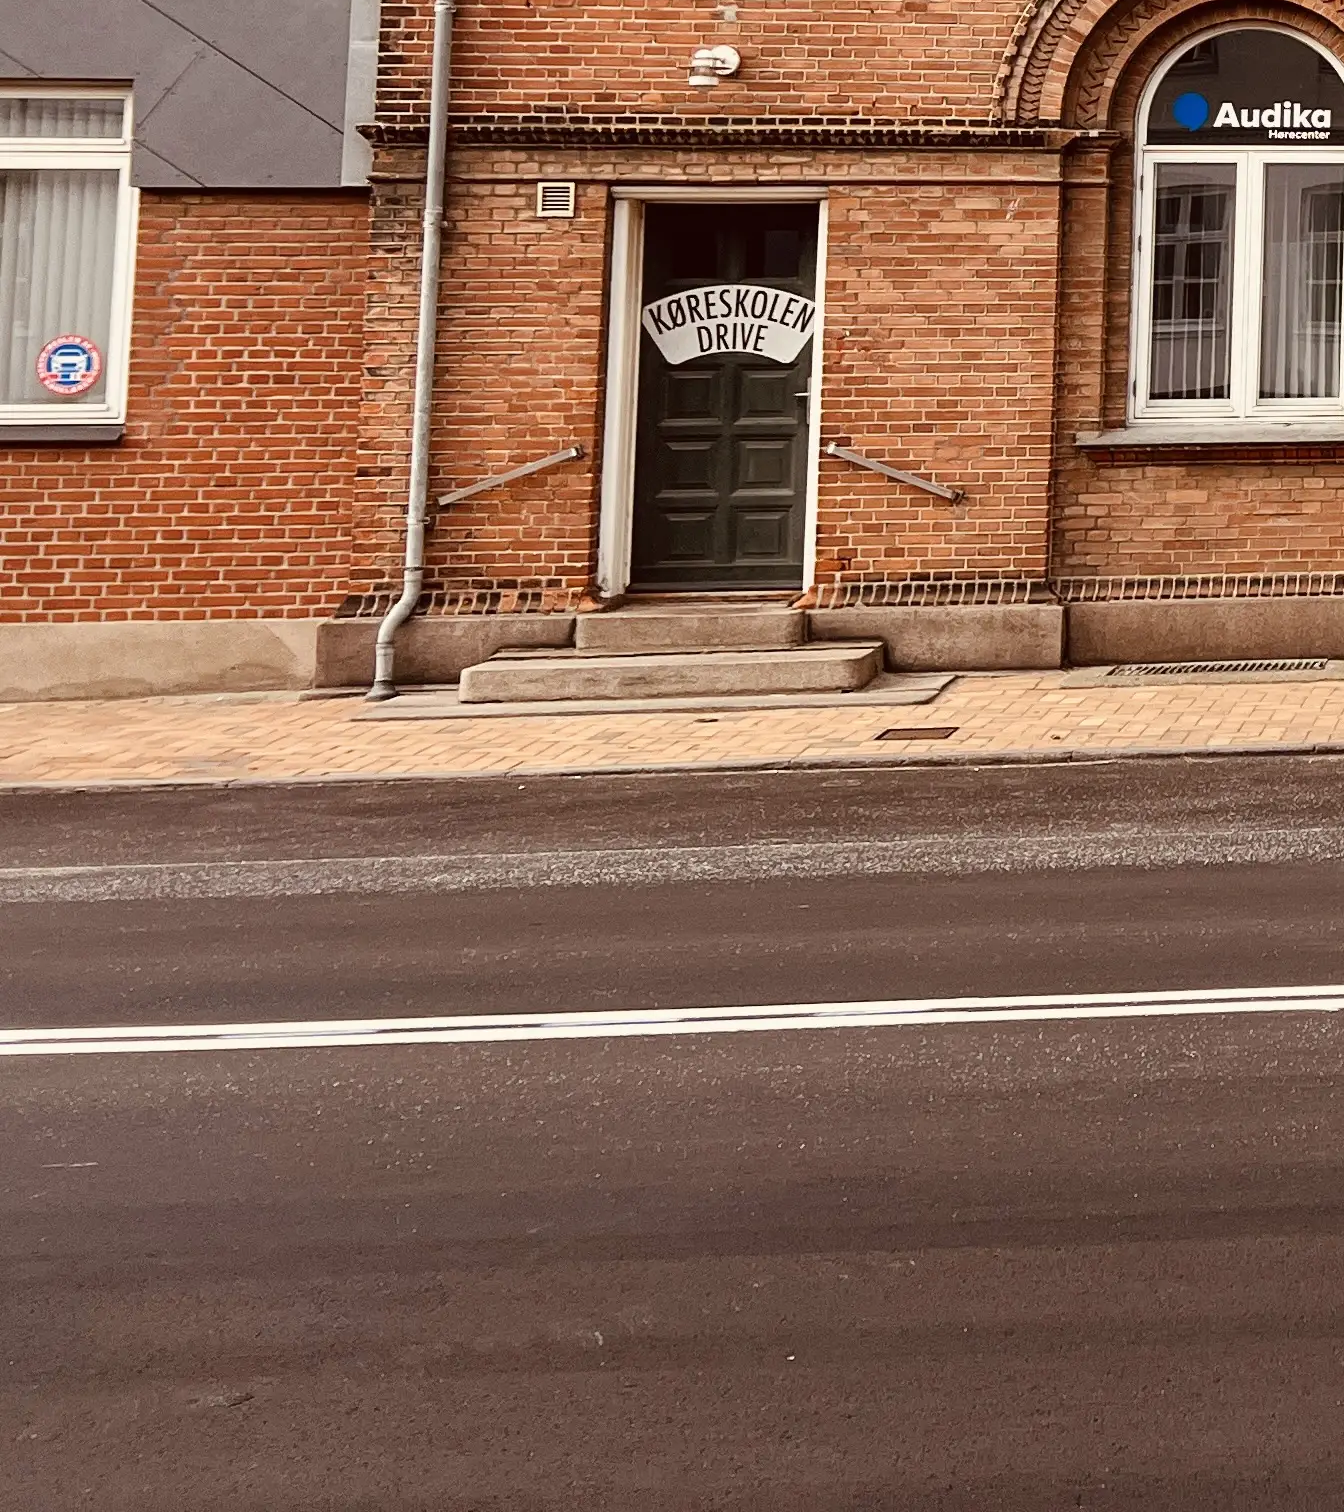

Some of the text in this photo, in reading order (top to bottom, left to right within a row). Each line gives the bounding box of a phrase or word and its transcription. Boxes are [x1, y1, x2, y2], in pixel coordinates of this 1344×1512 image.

[1213, 100, 1332, 128] Audika
[1268, 129, 1331, 140] Hørecenter
[647, 288, 816, 336] KØRESKOLEN
[696, 322, 769, 353] DRIVE
